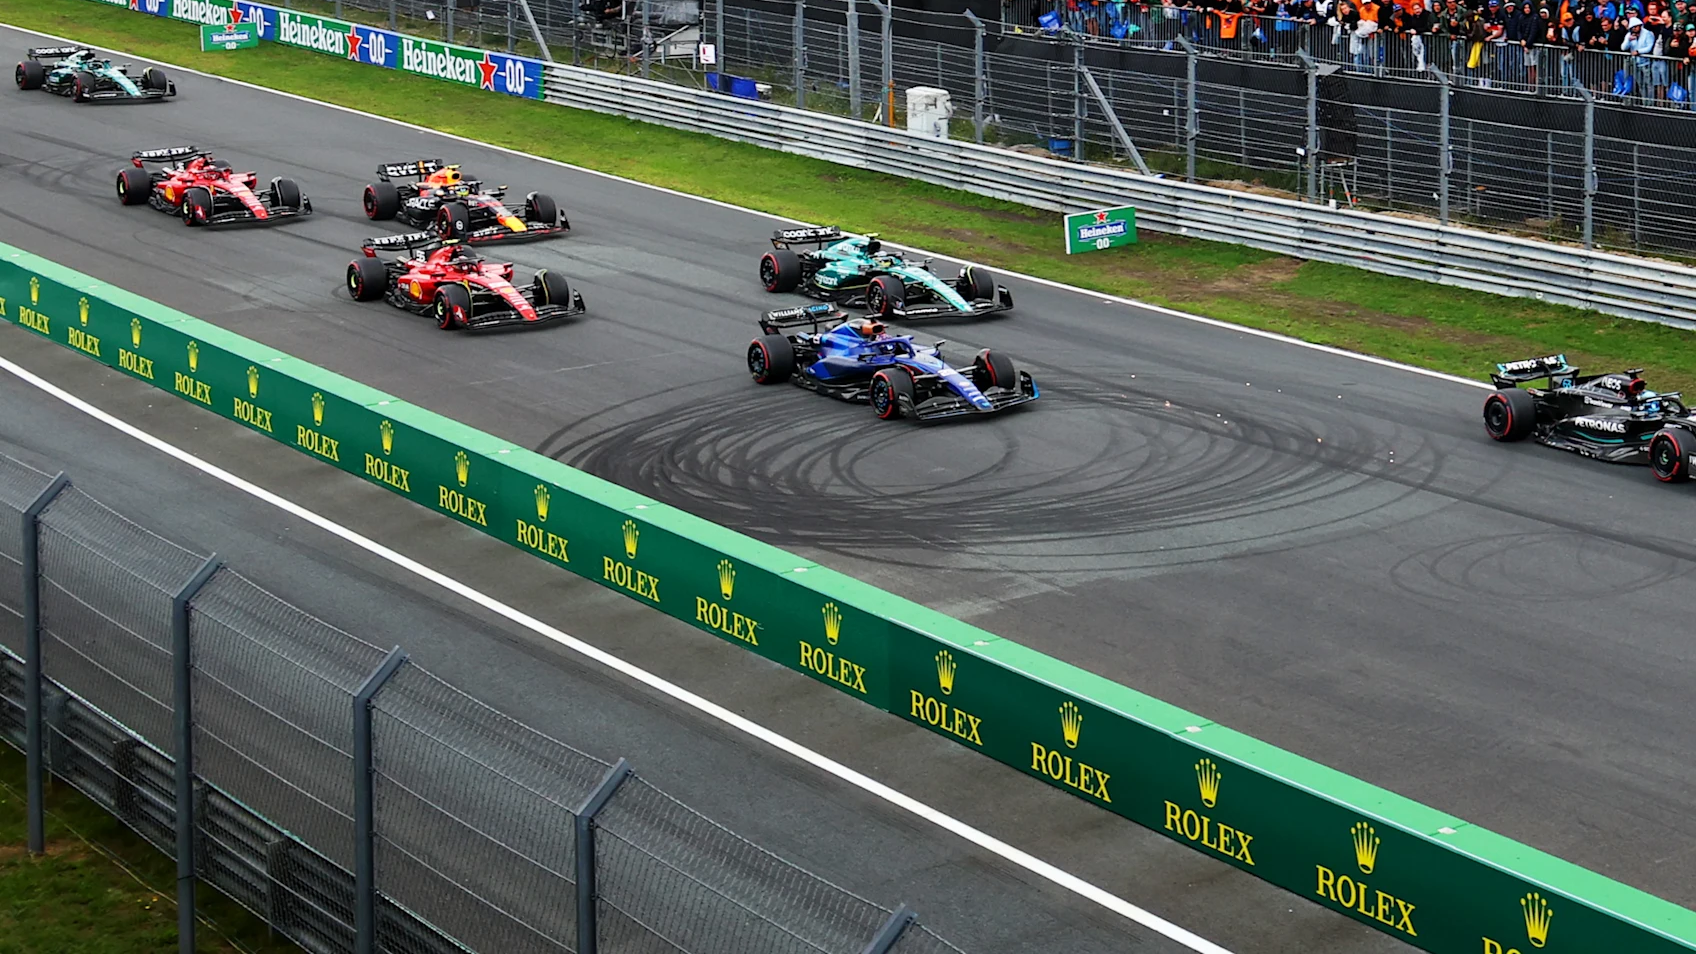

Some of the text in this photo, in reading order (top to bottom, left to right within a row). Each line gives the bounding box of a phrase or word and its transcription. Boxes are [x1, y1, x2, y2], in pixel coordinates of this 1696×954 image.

[279, 12, 344, 55] Heineken
[402, 38, 476, 84] Heineken
[1080, 223, 1124, 239] Heineken
[20, 306, 49, 334] ROLEX
[69, 327, 100, 357] ROLEX
[119, 349, 153, 379] ROLEX
[175, 373, 211, 405] ROLEX
[234, 398, 272, 432] ROLEX
[1575, 416, 1627, 433] PETRONAS
[298, 425, 339, 461] ROLEX
[365, 454, 410, 492] ROLEX
[439, 485, 487, 526] ROLEX
[517, 520, 569, 562] ROLEX
[603, 556, 660, 602] ROLEX
[696, 597, 758, 645] ROLEX
[799, 641, 867, 693] ROLEX
[911, 689, 983, 745] ROLEX
[1031, 742, 1112, 803] ROLEX
[1165, 800, 1255, 866] ROLEX
[1316, 865, 1417, 937] ROLEX
